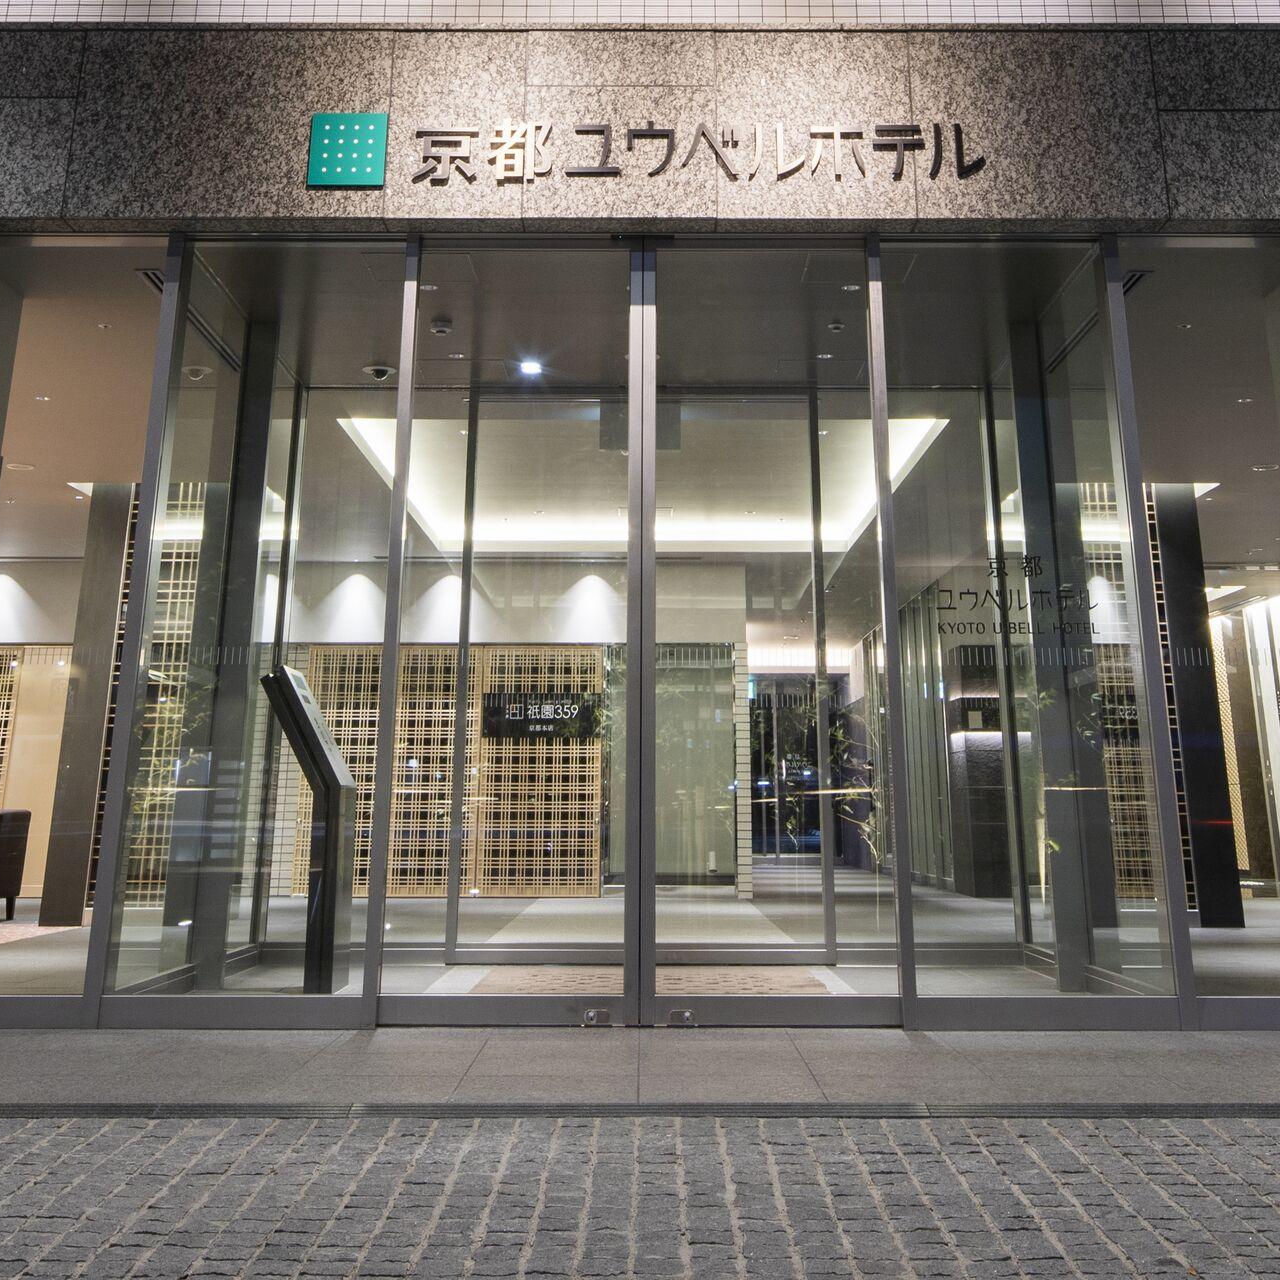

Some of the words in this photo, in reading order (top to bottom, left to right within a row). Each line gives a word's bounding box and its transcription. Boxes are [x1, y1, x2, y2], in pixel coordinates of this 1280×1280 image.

[413, 121, 987, 182] 京都ユウベルホテル
[986, 555, 1043, 578] 京都
[936, 588, 1099, 611] ユウベルホテル
[938, 622, 986, 635] KYOTO
[1053, 622, 1100, 635] HOTEL
[526, 704, 579, 719] 祇園359
